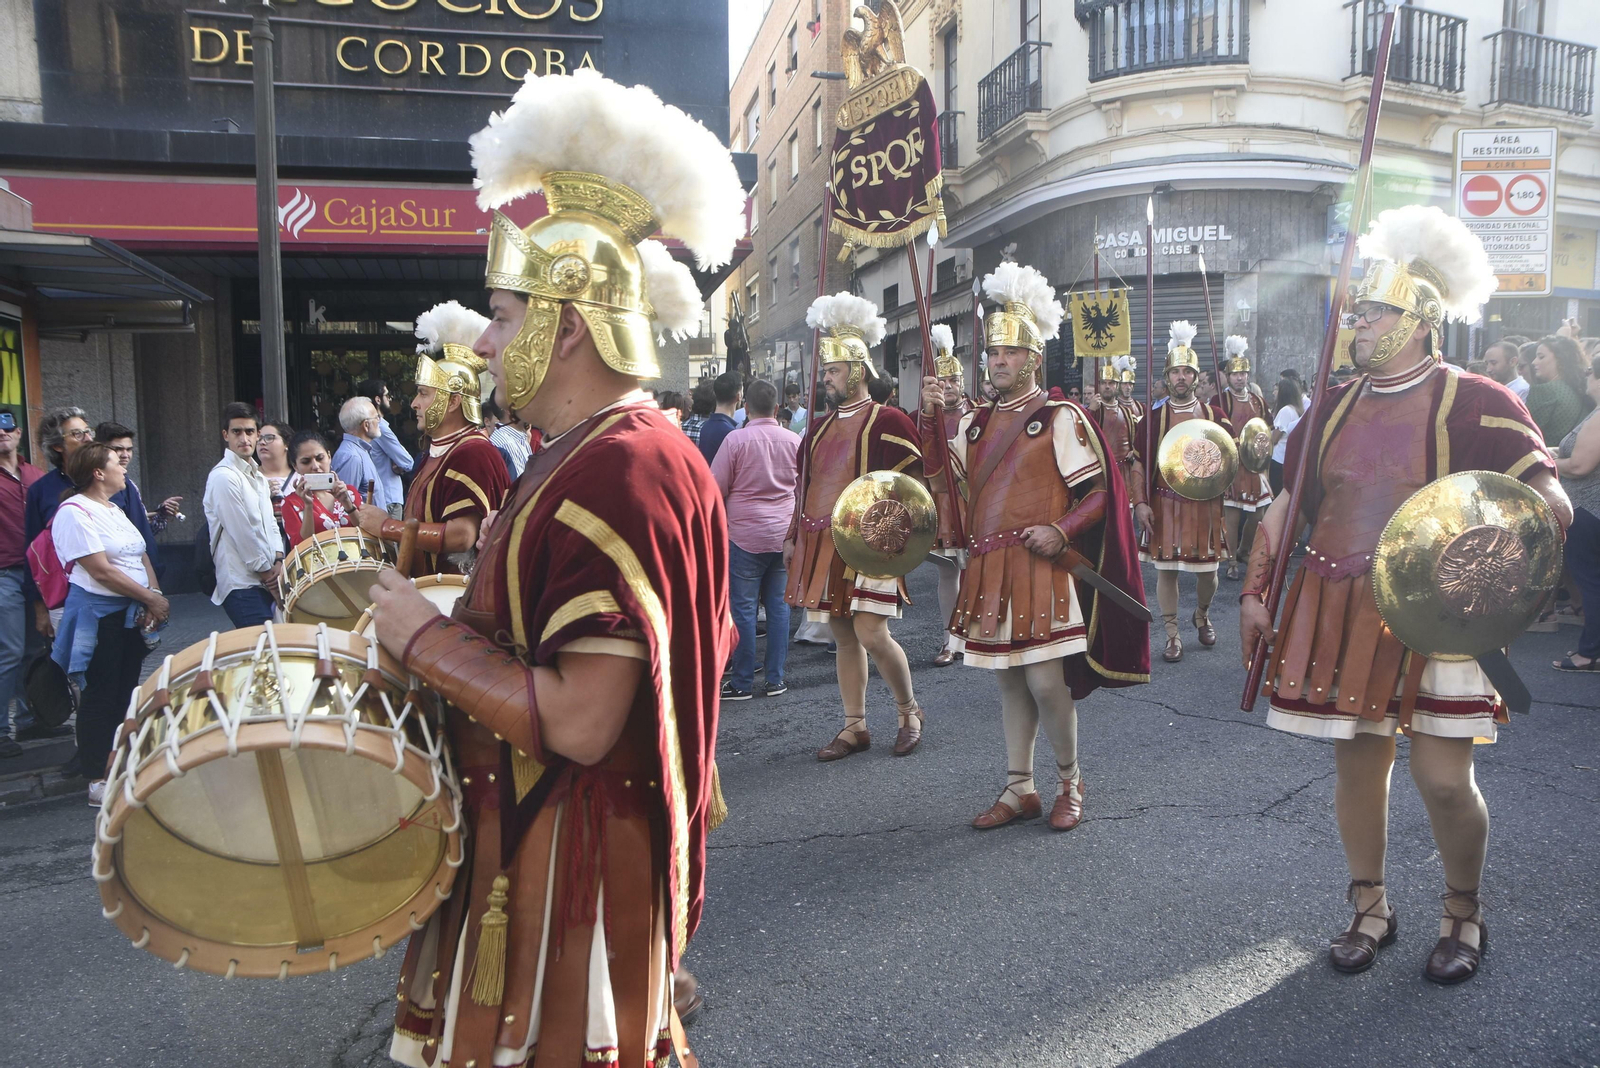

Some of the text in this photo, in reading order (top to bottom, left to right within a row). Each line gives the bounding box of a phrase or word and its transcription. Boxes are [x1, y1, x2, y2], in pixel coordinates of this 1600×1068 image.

[190, 26, 598, 81] DE CORDOBA
[853, 79, 902, 122] SPQR
[1472, 146, 1540, 155] RESTRINGIDA
[1493, 134, 1521, 144] ÁREA
[851, 127, 925, 189] SPQR
[1516, 191, 1535, 199] 1.80
[324, 198, 456, 235] CajaSur
[1095, 225, 1232, 249] CASA MIGUEL
[308, 299, 326, 325] k
